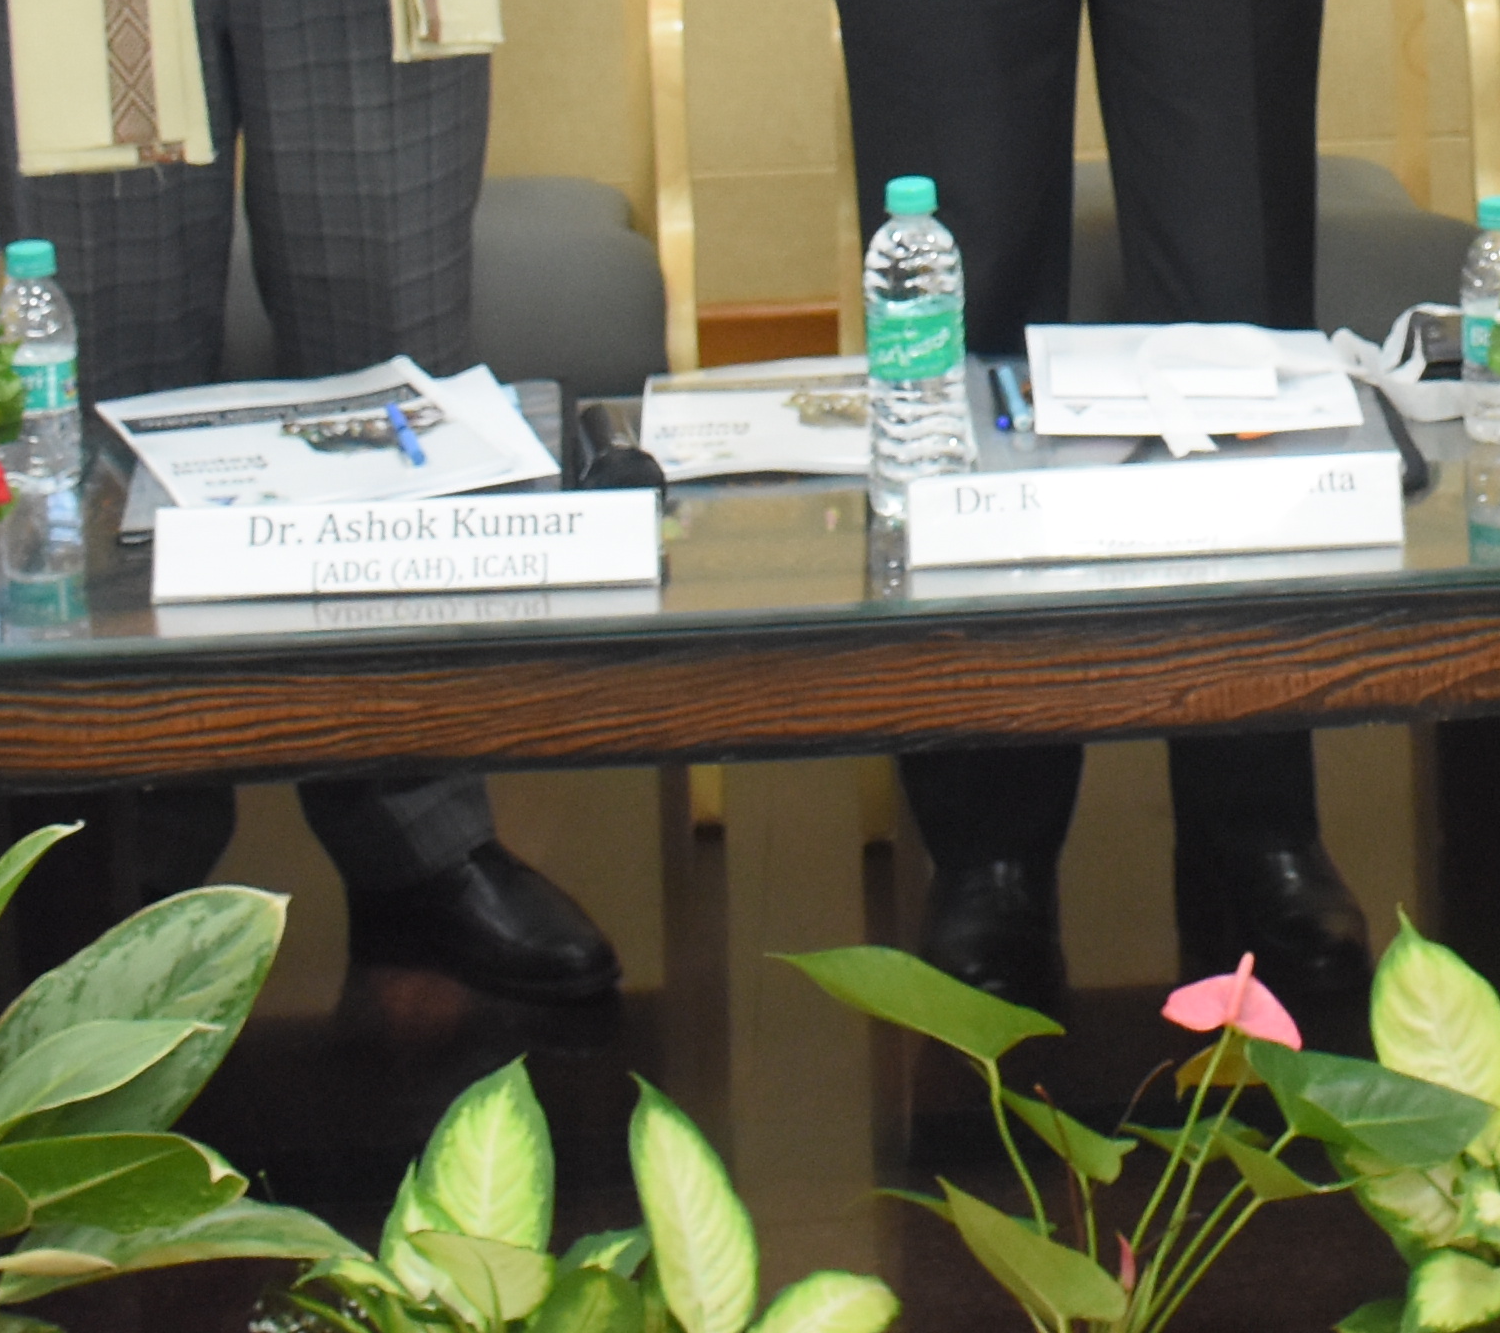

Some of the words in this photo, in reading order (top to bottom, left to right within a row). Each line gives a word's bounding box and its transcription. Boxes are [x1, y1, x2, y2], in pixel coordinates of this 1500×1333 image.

[955, 486, 1005, 515] Dr.
[248, 515, 303, 548] Dr.
[317, 508, 437, 545] Ashok
[451, 507, 584, 540] Kumar
[312, 560, 381, 593] [ADG
[390, 556, 464, 589] (AH),
[472, 551, 550, 585] ICAR]
